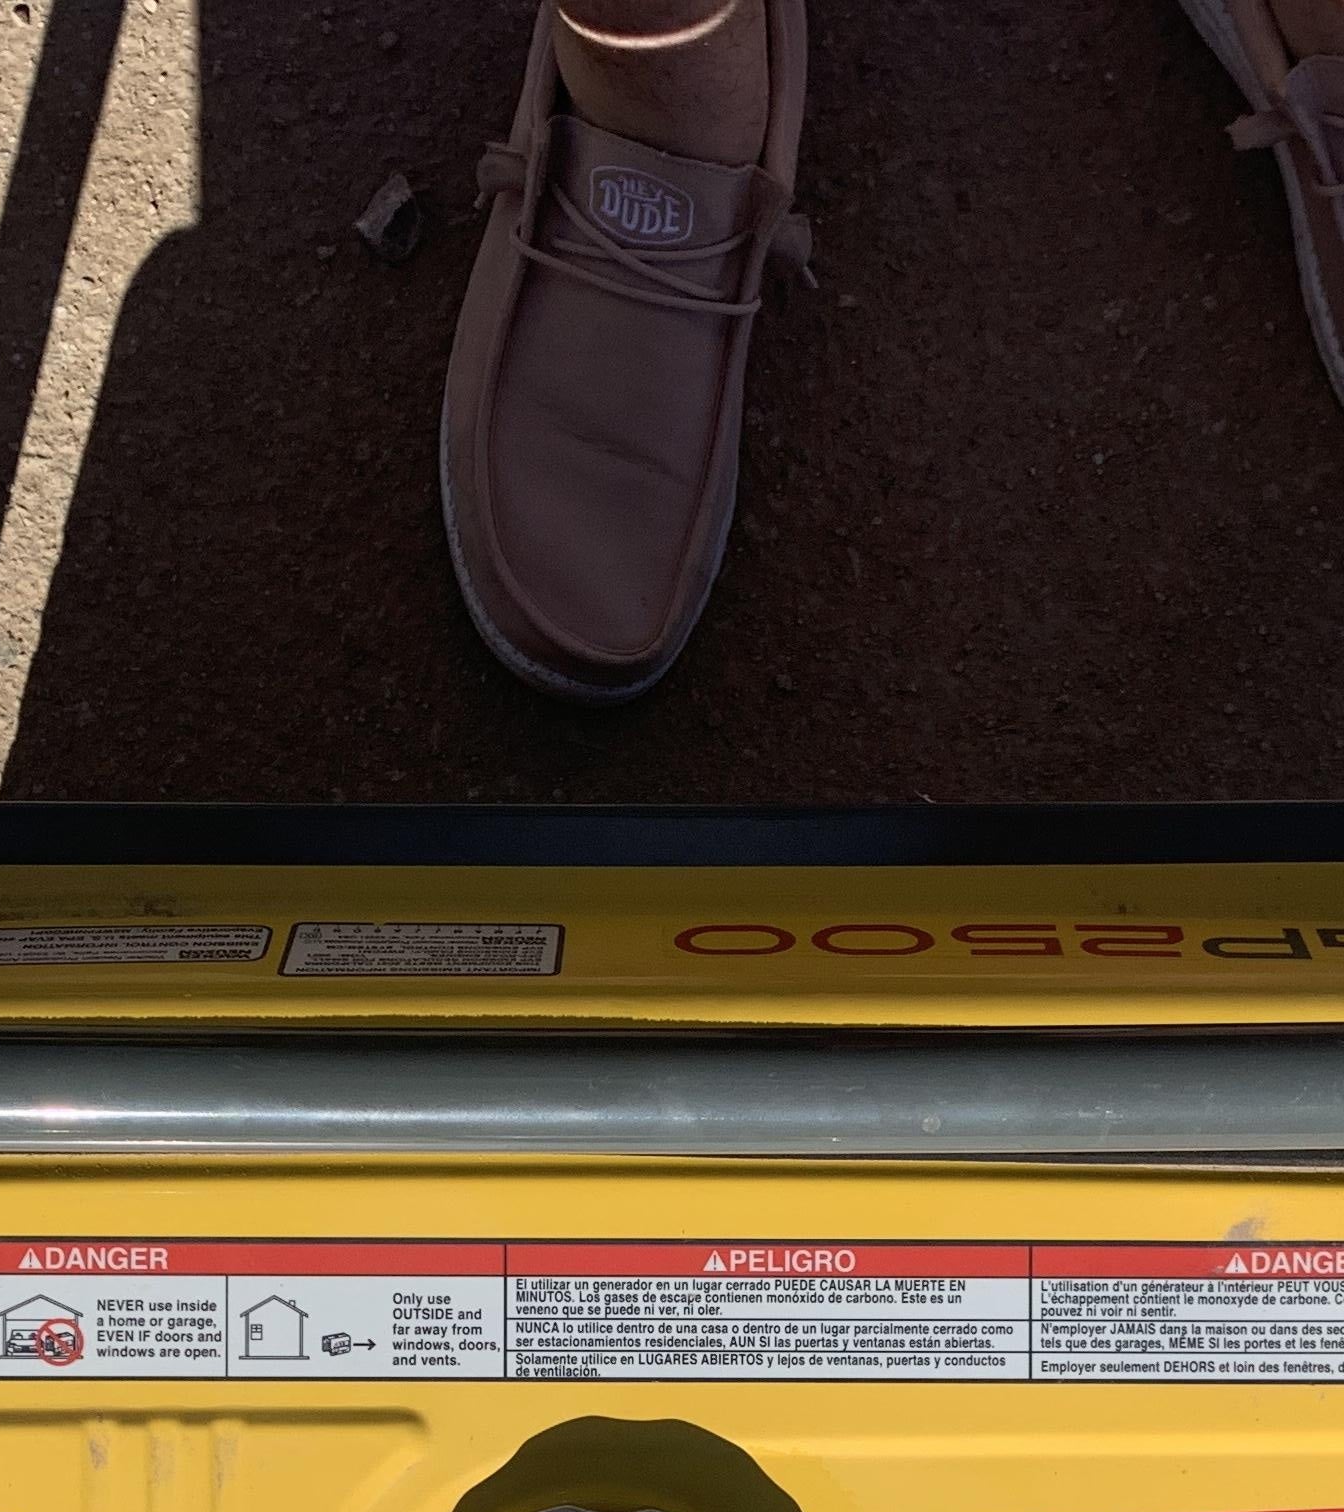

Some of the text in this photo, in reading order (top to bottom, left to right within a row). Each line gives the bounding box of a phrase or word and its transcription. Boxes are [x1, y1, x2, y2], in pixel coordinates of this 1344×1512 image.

[600, 178, 681, 234] DUDE
[45, 1248, 168, 1270] DANGER
[729, 1249, 856, 1273] PELIGRO
[516, 1279, 966, 1293] El utilizar un generador en un lugar cerrado PUEDE CAUSAR LA MUERTE EN
[1040, 1281, 1109, 1292] L'utilisation
[1112, 1281, 1138, 1292] d'un
[1140, 1281, 1205, 1295] générateur
[1207, 1281, 1215, 1292] à
[1217, 1281, 1274, 1292] l'intérieur
[1277, 1281, 1310, 1292] PEUT
[96, 1300, 217, 1312] NEVER use inside
[392, 1292, 452, 1309] Only use
[392, 1308, 482, 1320] OUTSIDE and
[96, 1315, 217, 1331] a home or garage,
[97, 1330, 222, 1343] EVEN IF doors and
[392, 1324, 483, 1340] far away from
[392, 1338, 501, 1353] windows, doors,
[96, 1345, 221, 1362] windows are open.
[391, 1354, 461, 1366] and vents.
[515, 1354, 1006, 1369] Solamente utilice en LUGARES ABIERTOS y lejos de ventanas, puertas y conductos
[1040, 1362, 1097, 1376] Employer
[1099, 1362, 1161, 1373] seulement
[1163, 1362, 1216, 1373] DEHORS
[1218, 1362, 1230, 1373] et
[1233, 1362, 1255, 1373] loin
[1258, 1362, 1280, 1373] des
[1282, 1362, 1335, 1375] fenêtres,
